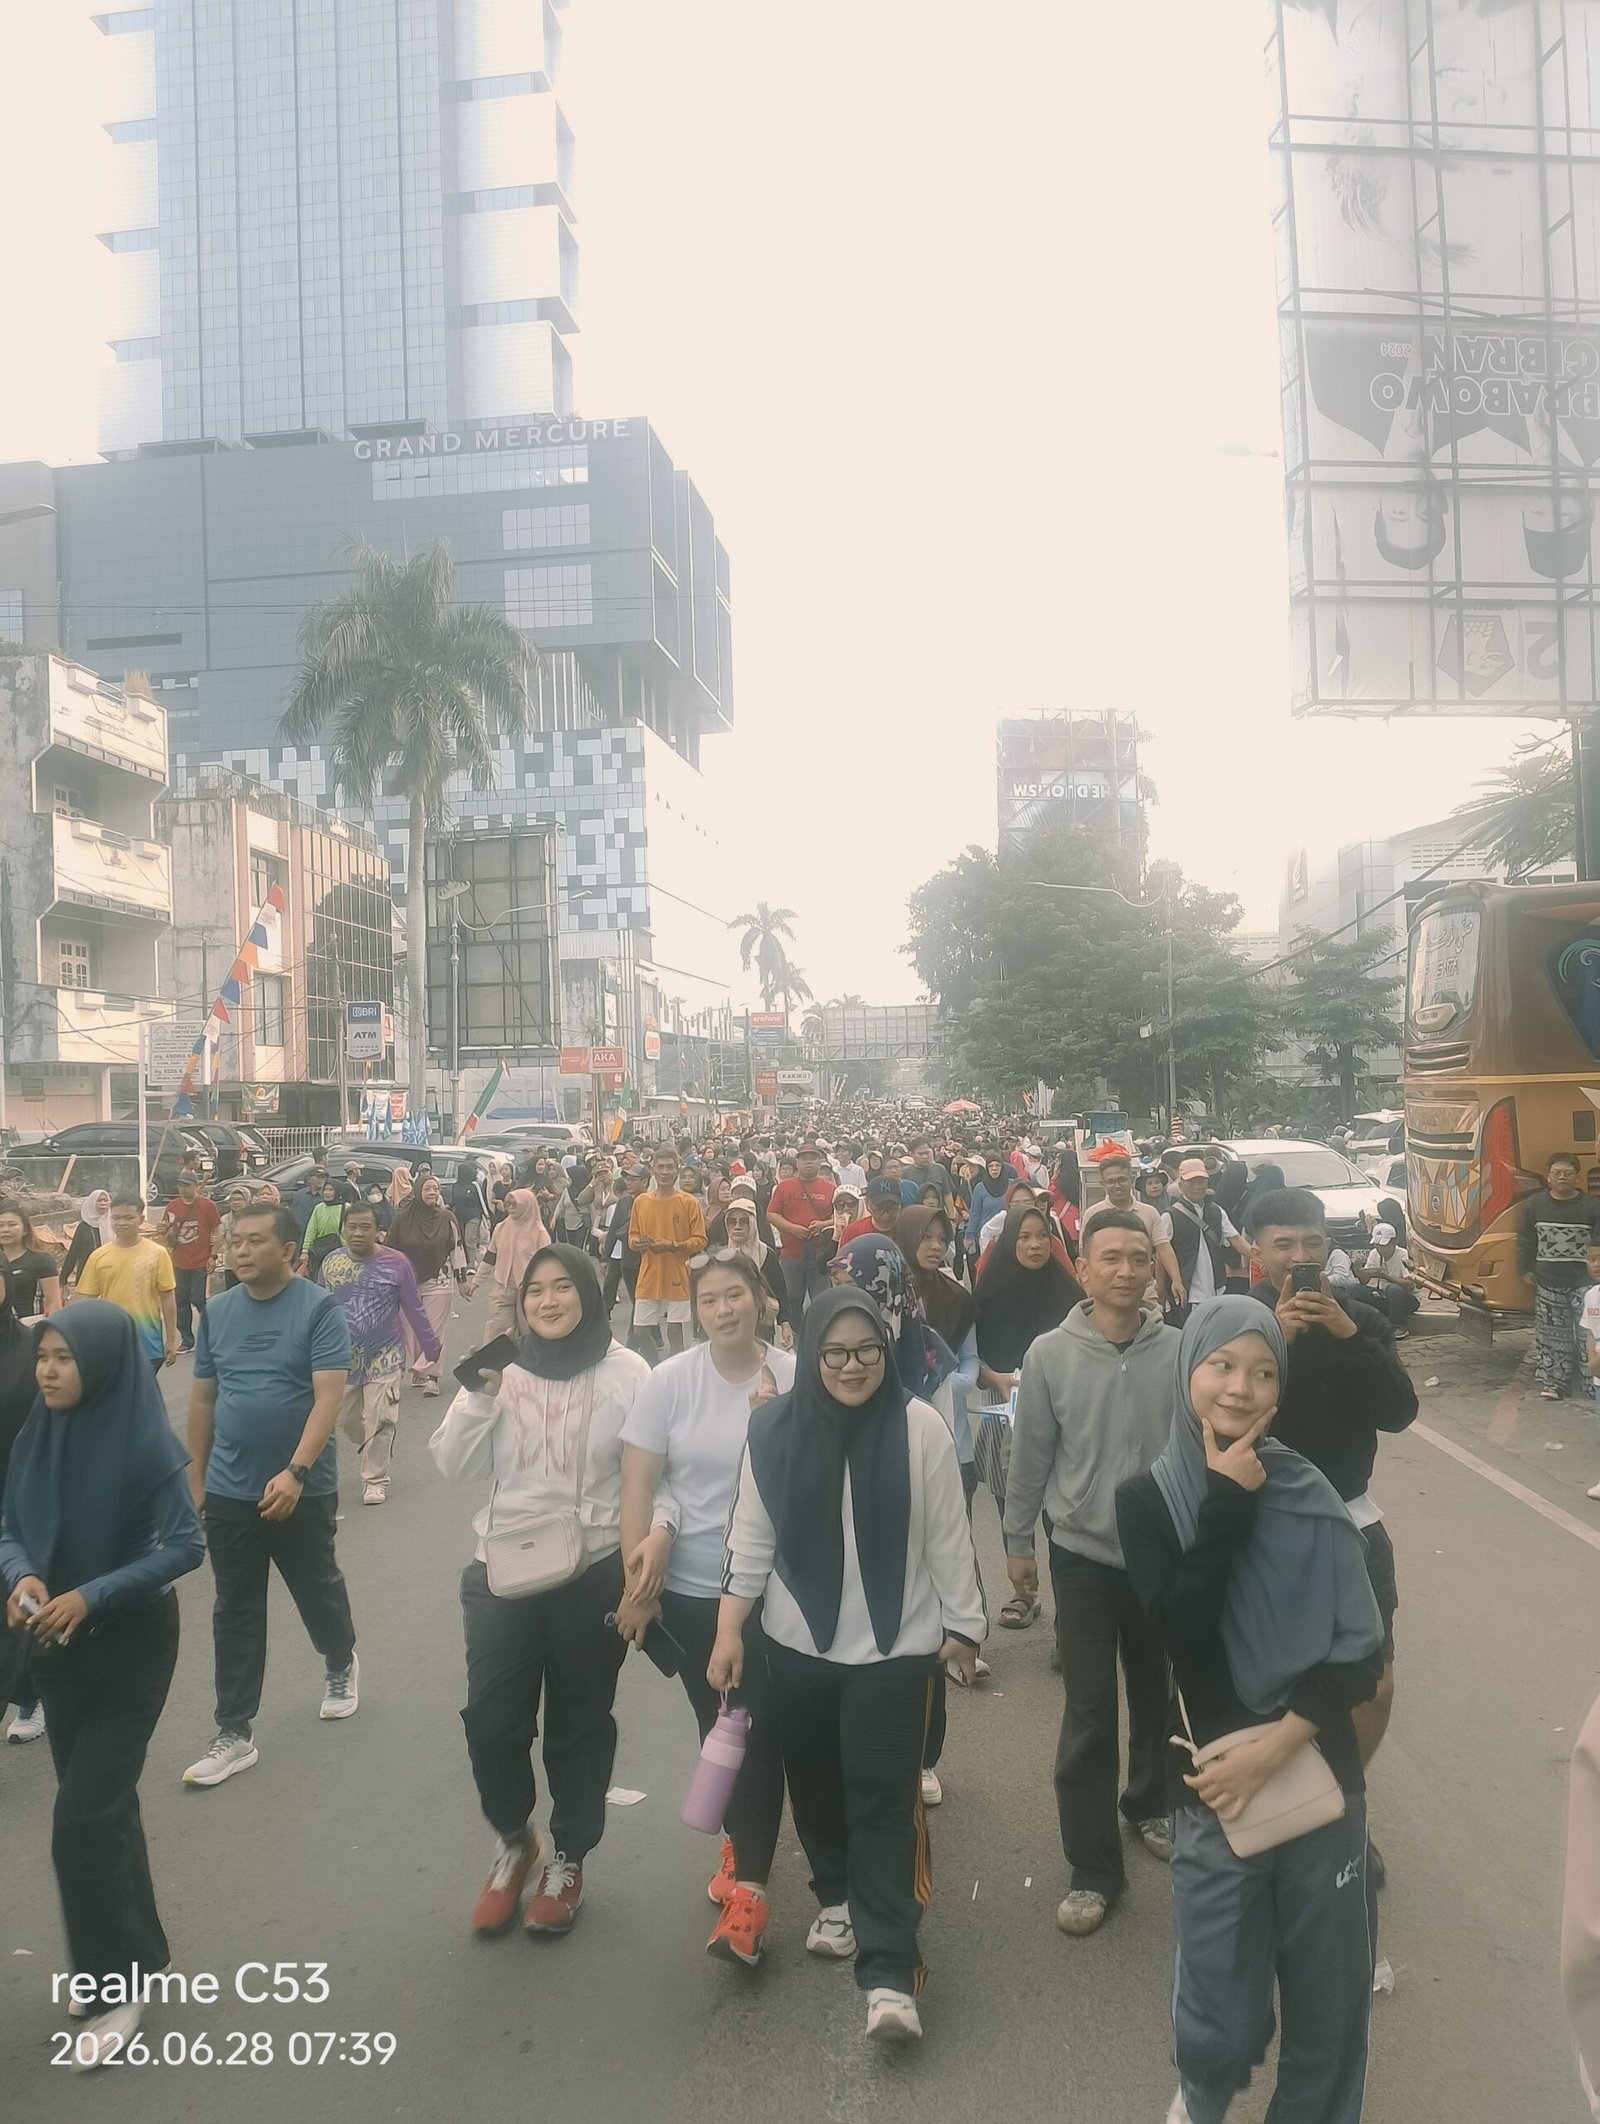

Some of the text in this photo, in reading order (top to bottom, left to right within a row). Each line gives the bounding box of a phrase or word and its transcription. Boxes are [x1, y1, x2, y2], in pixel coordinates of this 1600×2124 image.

[1380, 342, 1412, 358] 2024
[1421, 334, 1600, 379] GIBRAN
[1369, 372, 1600, 420] PRABOWO
[354, 418, 630, 460] GRAND MERCURE
[362, 1007, 377, 1016] BRI
[353, 1031, 377, 1039] ATM
[594, 1053, 616, 1062] AKA
